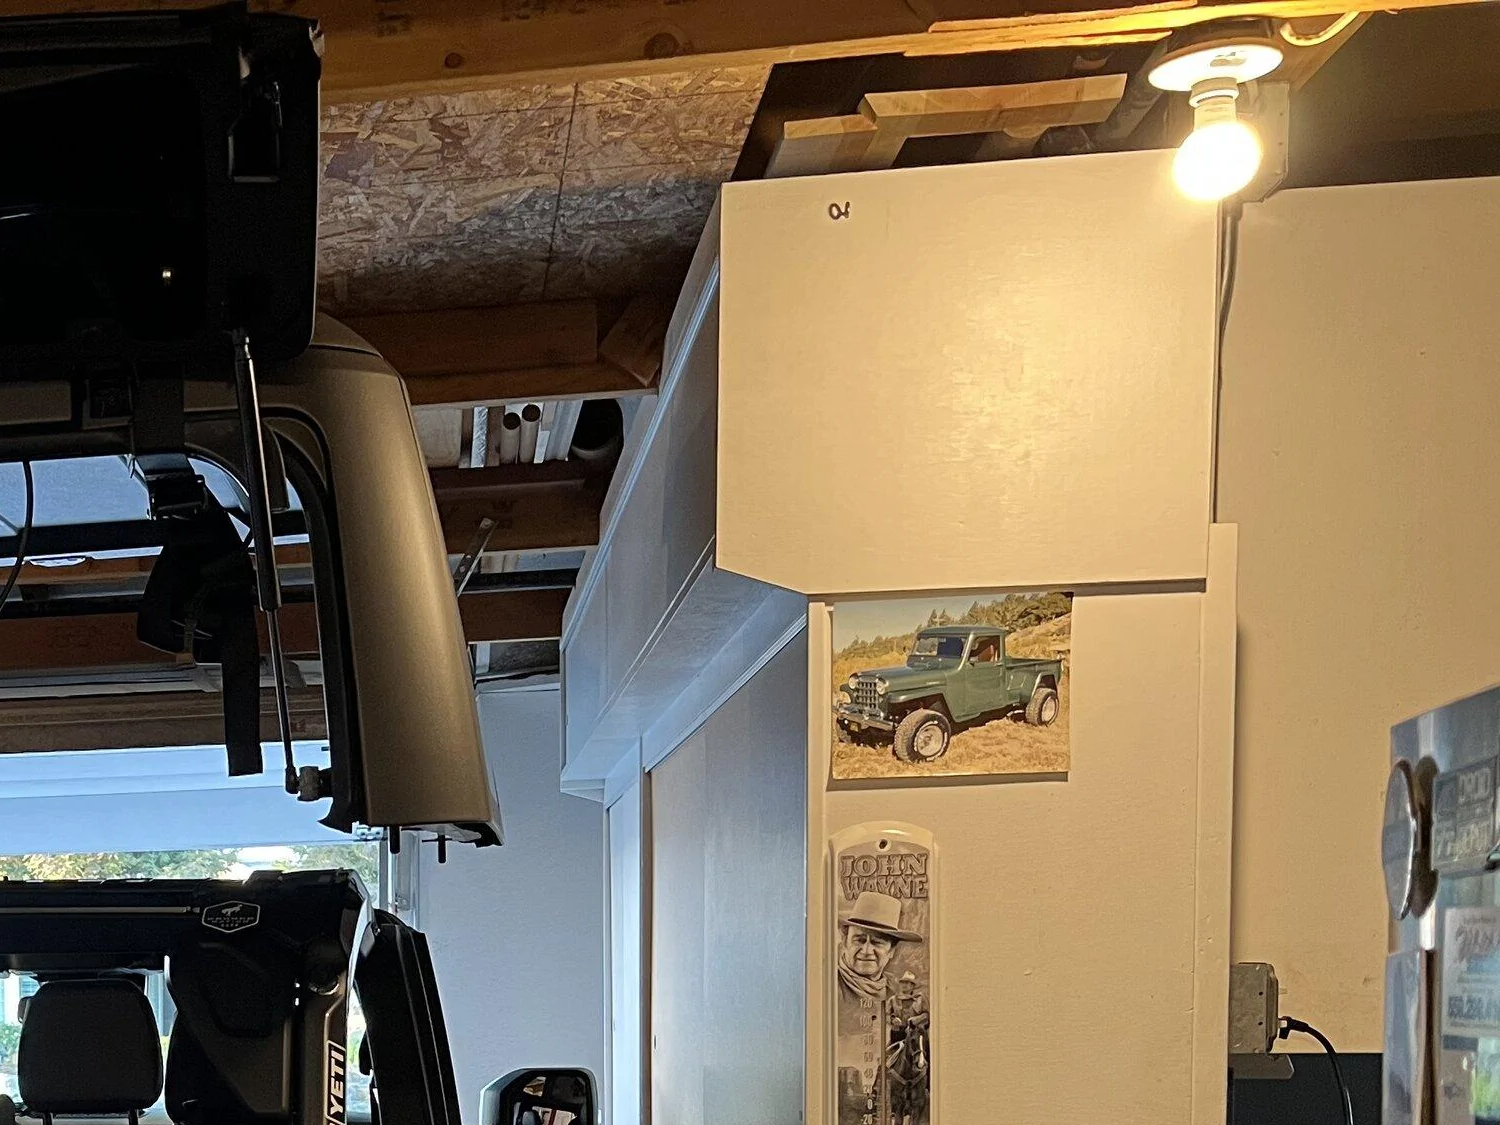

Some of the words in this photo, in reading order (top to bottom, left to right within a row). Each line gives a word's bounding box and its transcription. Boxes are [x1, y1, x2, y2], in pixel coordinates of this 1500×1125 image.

[840, 853, 928, 877] JOHN
[840, 874, 928, 901] WAYNE
[859, 998, 873, 1010] 120
[330, 1050, 345, 1115] YETI
